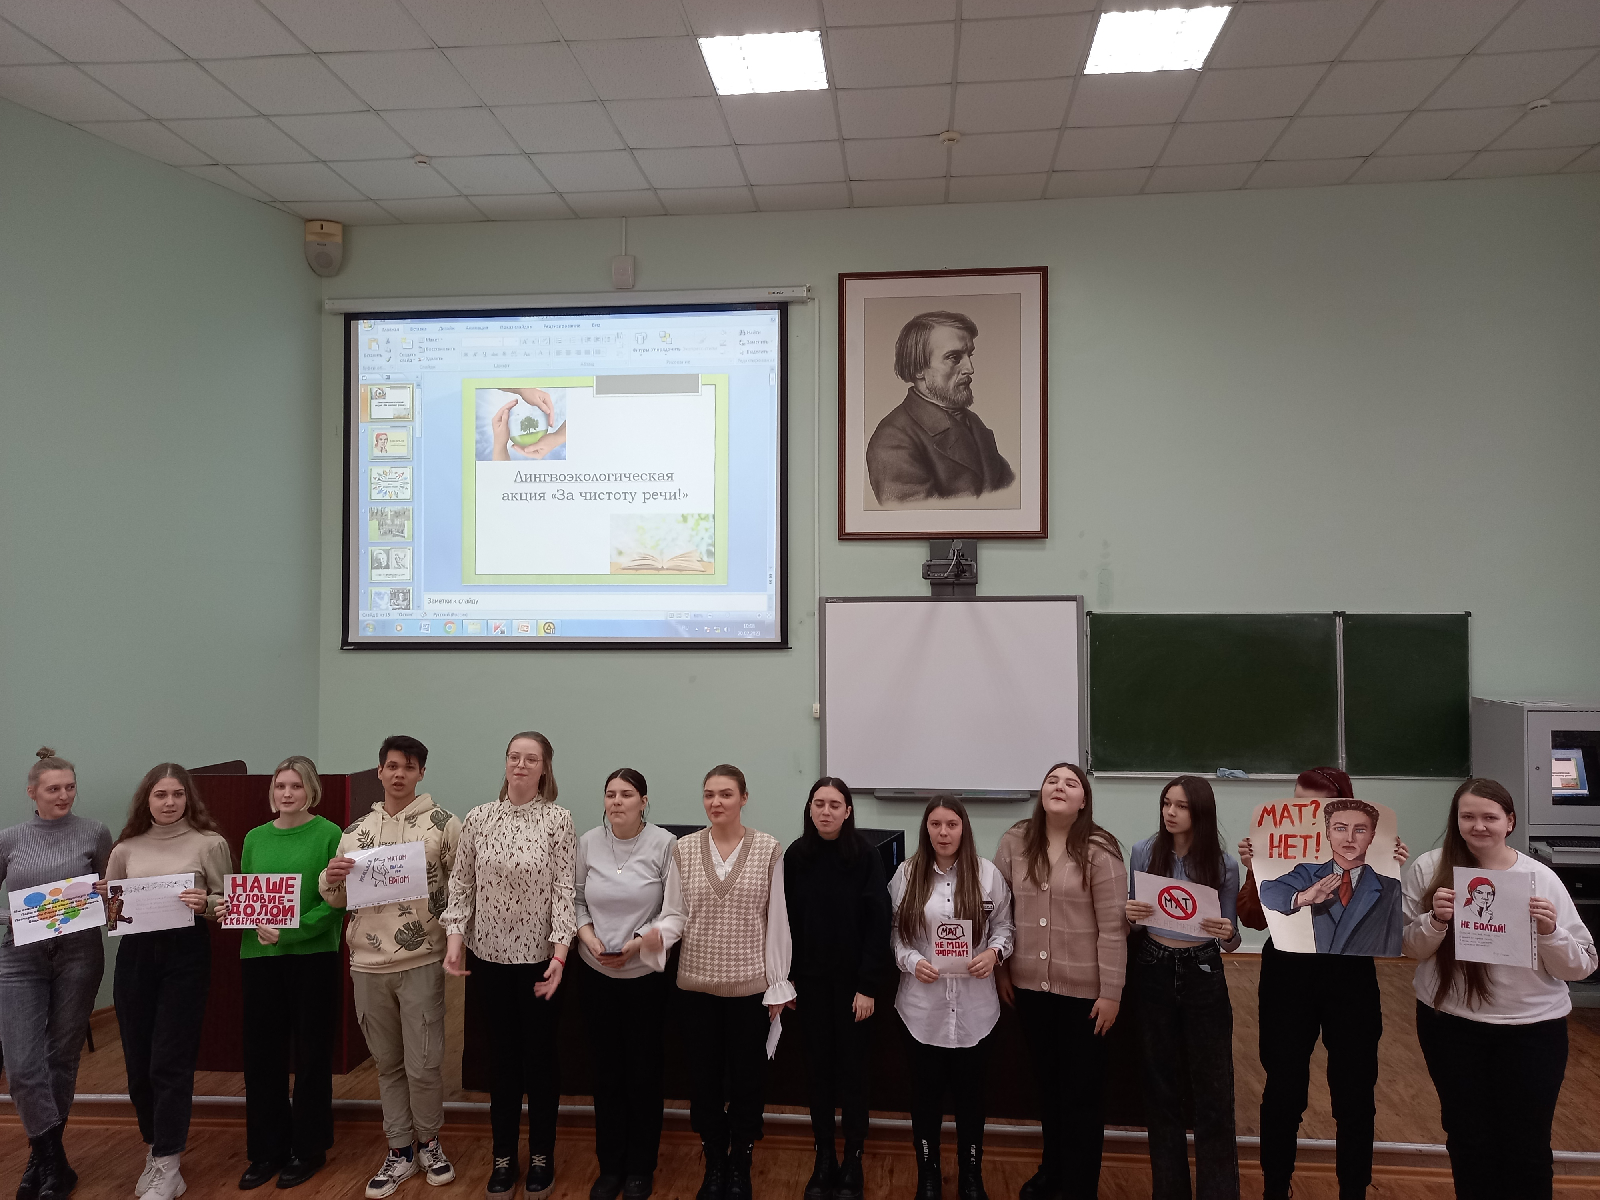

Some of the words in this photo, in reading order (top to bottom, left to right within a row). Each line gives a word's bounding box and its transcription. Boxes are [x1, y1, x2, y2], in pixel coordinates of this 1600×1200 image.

[513, 470, 675, 483] Лингвоэкологическая
[501, 491, 546, 503] акция
[551, 488, 575, 501] «За
[579, 489, 637, 504] чистоту
[642, 488, 690, 504] речи!»
[1257, 799, 1321, 828] МАТ?
[1268, 831, 1321, 860] НЕТ!
[230, 876, 297, 895] НАШЕ
[940, 926, 958, 937] МАТ
[1460, 920, 1471, 930] НЕ
[1473, 922, 1507, 934] БОЛТАЙ!
[934, 941, 944, 949] НЕ
[946, 941, 969, 949] МОЙ
[934, 949, 969, 958] ФОРМАТ!
